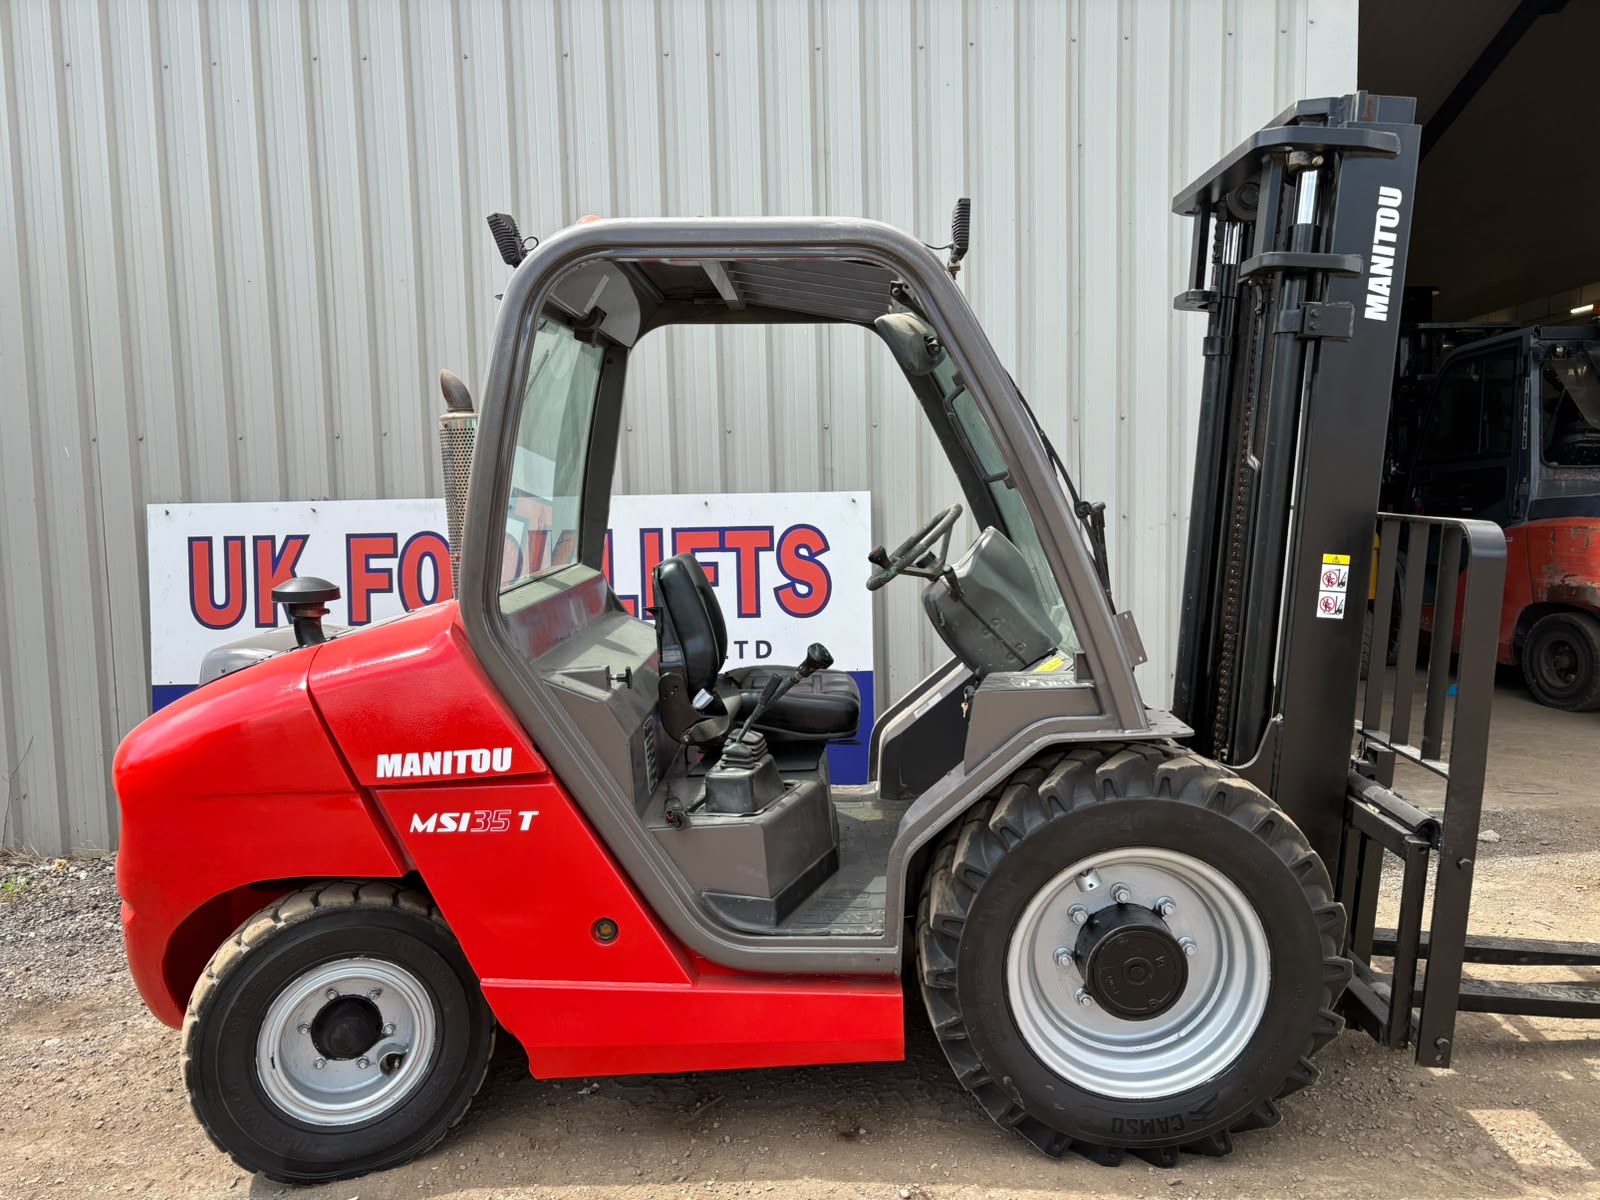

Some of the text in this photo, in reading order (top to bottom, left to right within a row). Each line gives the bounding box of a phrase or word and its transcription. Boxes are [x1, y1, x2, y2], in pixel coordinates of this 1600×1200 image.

[1364, 187, 1402, 321] MANITOU
[188, 524, 831, 629] UK FOLIFTS
[724, 640, 772, 659] TD
[377, 748, 513, 779] MANITOU
[409, 809, 540, 832] MSI35 T
[1111, 1114, 1184, 1135] CAMSO
